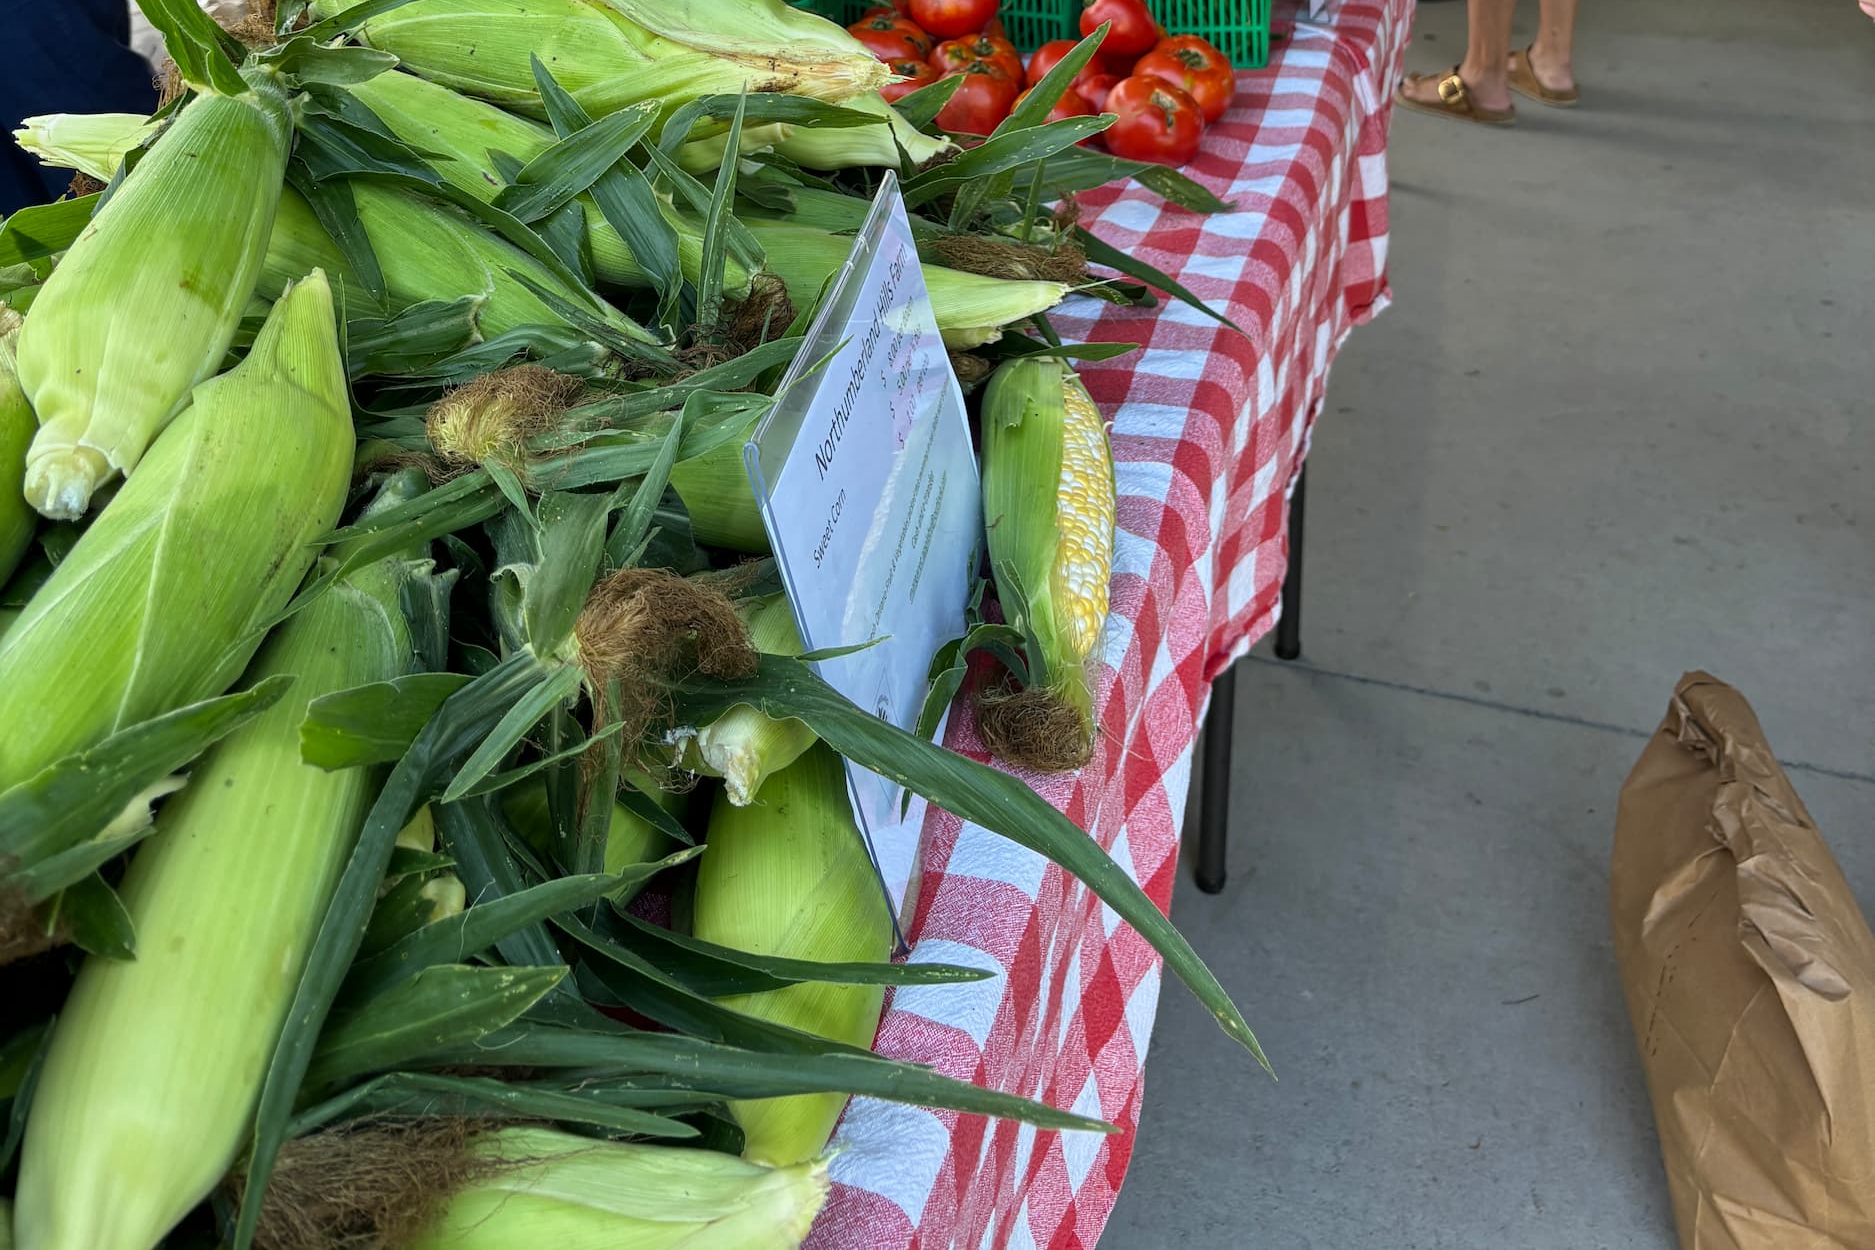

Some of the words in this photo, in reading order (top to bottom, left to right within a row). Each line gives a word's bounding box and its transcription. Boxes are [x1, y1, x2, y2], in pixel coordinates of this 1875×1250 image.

[814, 310, 881, 482] Northumberland
[877, 280, 894, 321] Hills
[890, 242, 907, 288] Farm
[813, 520, 834, 570] Sweet
[830, 488, 847, 524] Corn
